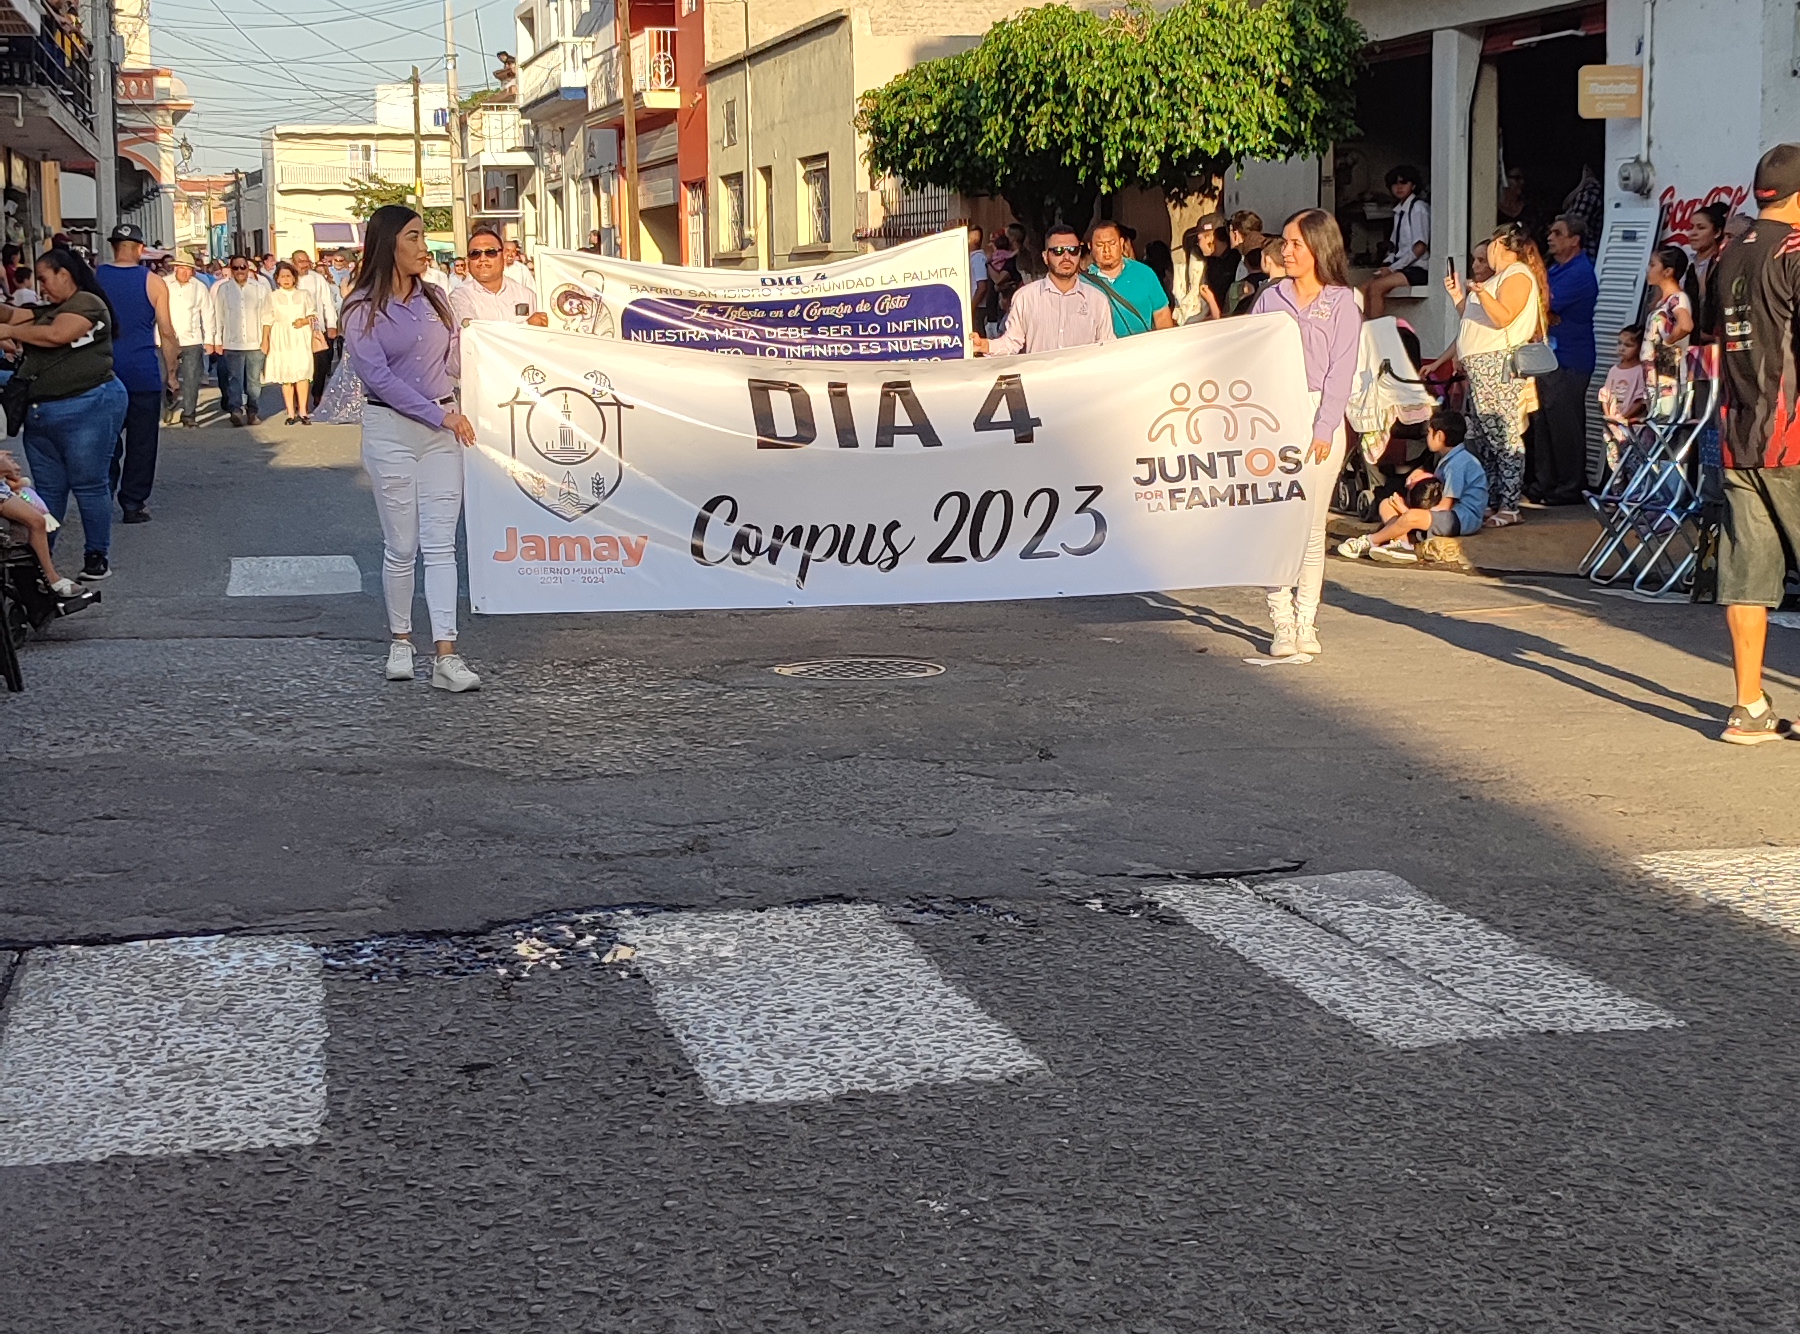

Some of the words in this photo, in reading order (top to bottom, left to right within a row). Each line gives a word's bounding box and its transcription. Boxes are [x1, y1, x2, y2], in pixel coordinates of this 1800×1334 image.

[630, 285, 682, 296] BARRIO
[688, 290, 717, 298] SAN
[776, 288, 784, 296] Y
[791, 277, 875, 295] COMUNIDAD
[881, 275, 898, 285] LA
[904, 267, 958, 282] PALMITA
[718, 306, 766, 320] Iglesia
[769, 309, 784, 318] en
[788, 304, 801, 318] el
[856, 299, 871, 310] de
[874, 294, 911, 315] Cristo
[631, 329, 709, 342] NUESTRA
[715, 327, 760, 340] META
[765, 326, 812, 338] DEBE
[818, 325, 852, 337] SER
[859, 323, 880, 335] LO
[887, 315, 959, 333] INFINITO,
[786, 343, 853, 358] INFINITO
[859, 341, 881, 354] ES
[888, 336, 963, 353] NUESTRA
[748, 378, 943, 450] DIA
[972, 373, 1042, 444] 4
[1133, 446, 1303, 486] JUNTOS
[1135, 490, 1164, 501] POR
[1148, 503, 1166, 513] LA
[1168, 480, 1306, 511] FAMILIA
[493, 527, 648, 567] Jamay
[690, 495, 915, 590] Corpus
[927, 485, 1108, 564] 2023
[518, 567, 571, 576] GOBIERNO
[573, 567, 626, 575] MUNICIPAL
[540, 576, 562, 584] 2021
[581, 576, 605, 584] 2024
